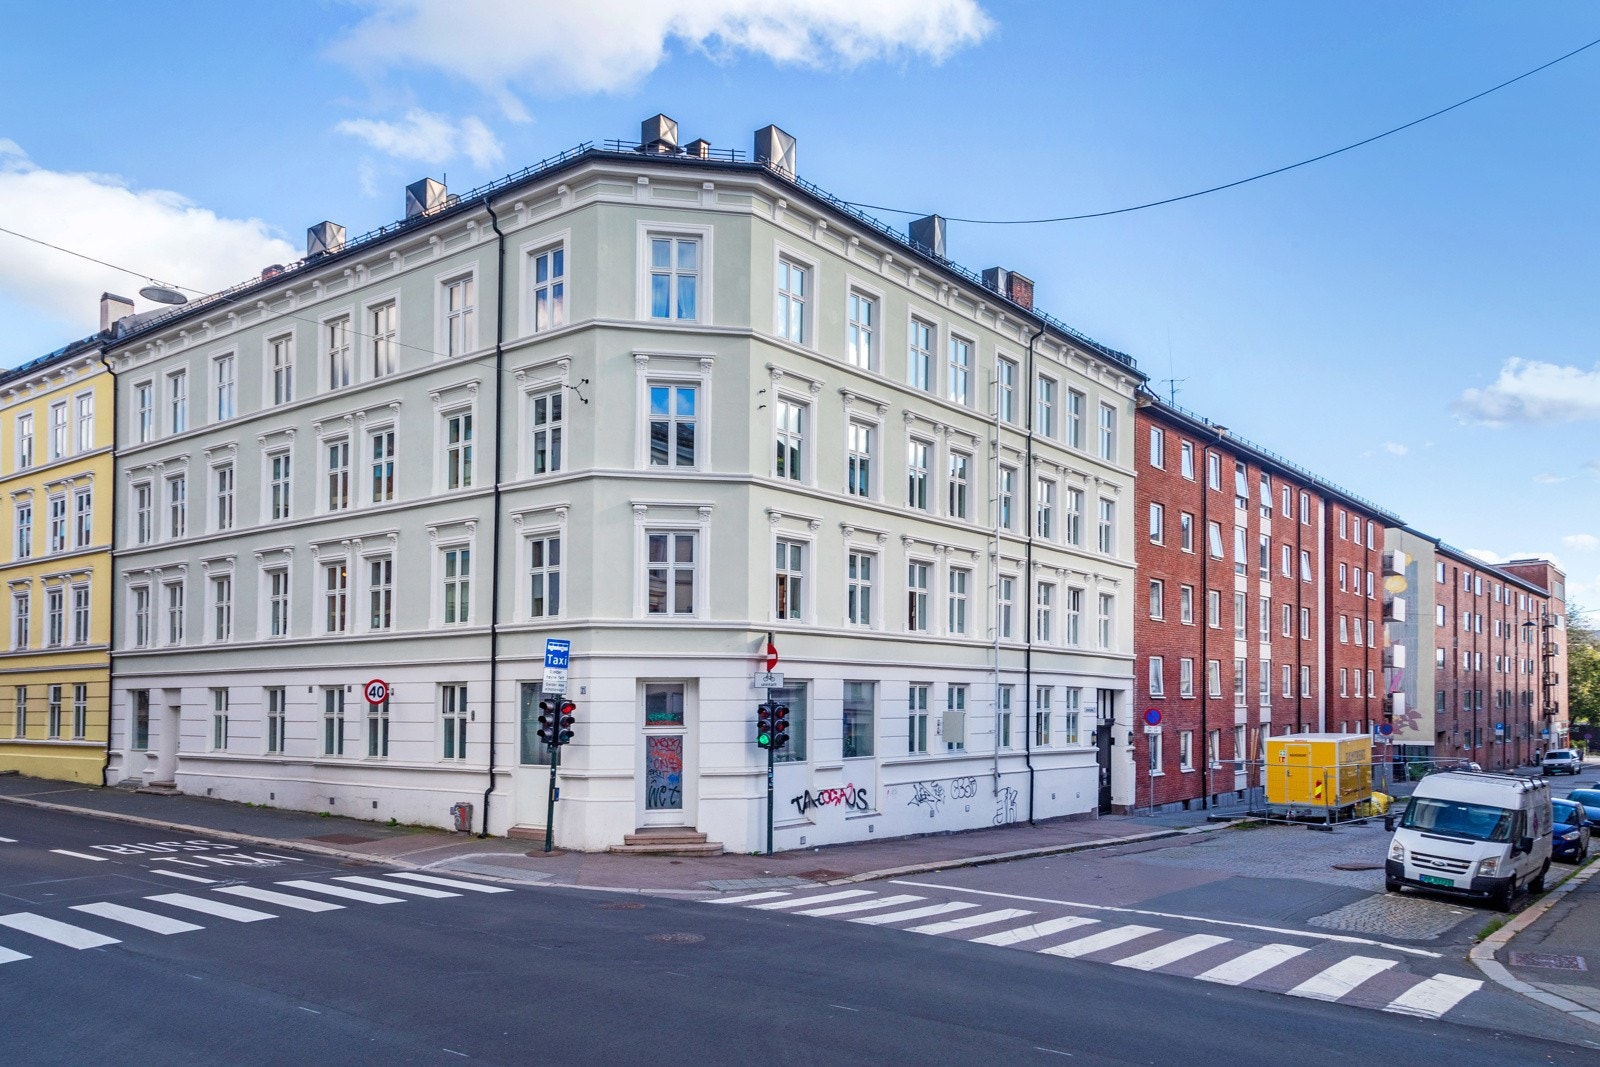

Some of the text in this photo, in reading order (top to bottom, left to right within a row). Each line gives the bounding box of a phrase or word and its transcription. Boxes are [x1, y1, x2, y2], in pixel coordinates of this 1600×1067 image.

[547, 654, 567, 665] Taxi
[369, 685, 385, 698] 40
[89, 840, 239, 855] BUSS
[149, 851, 304, 868] TAXI
